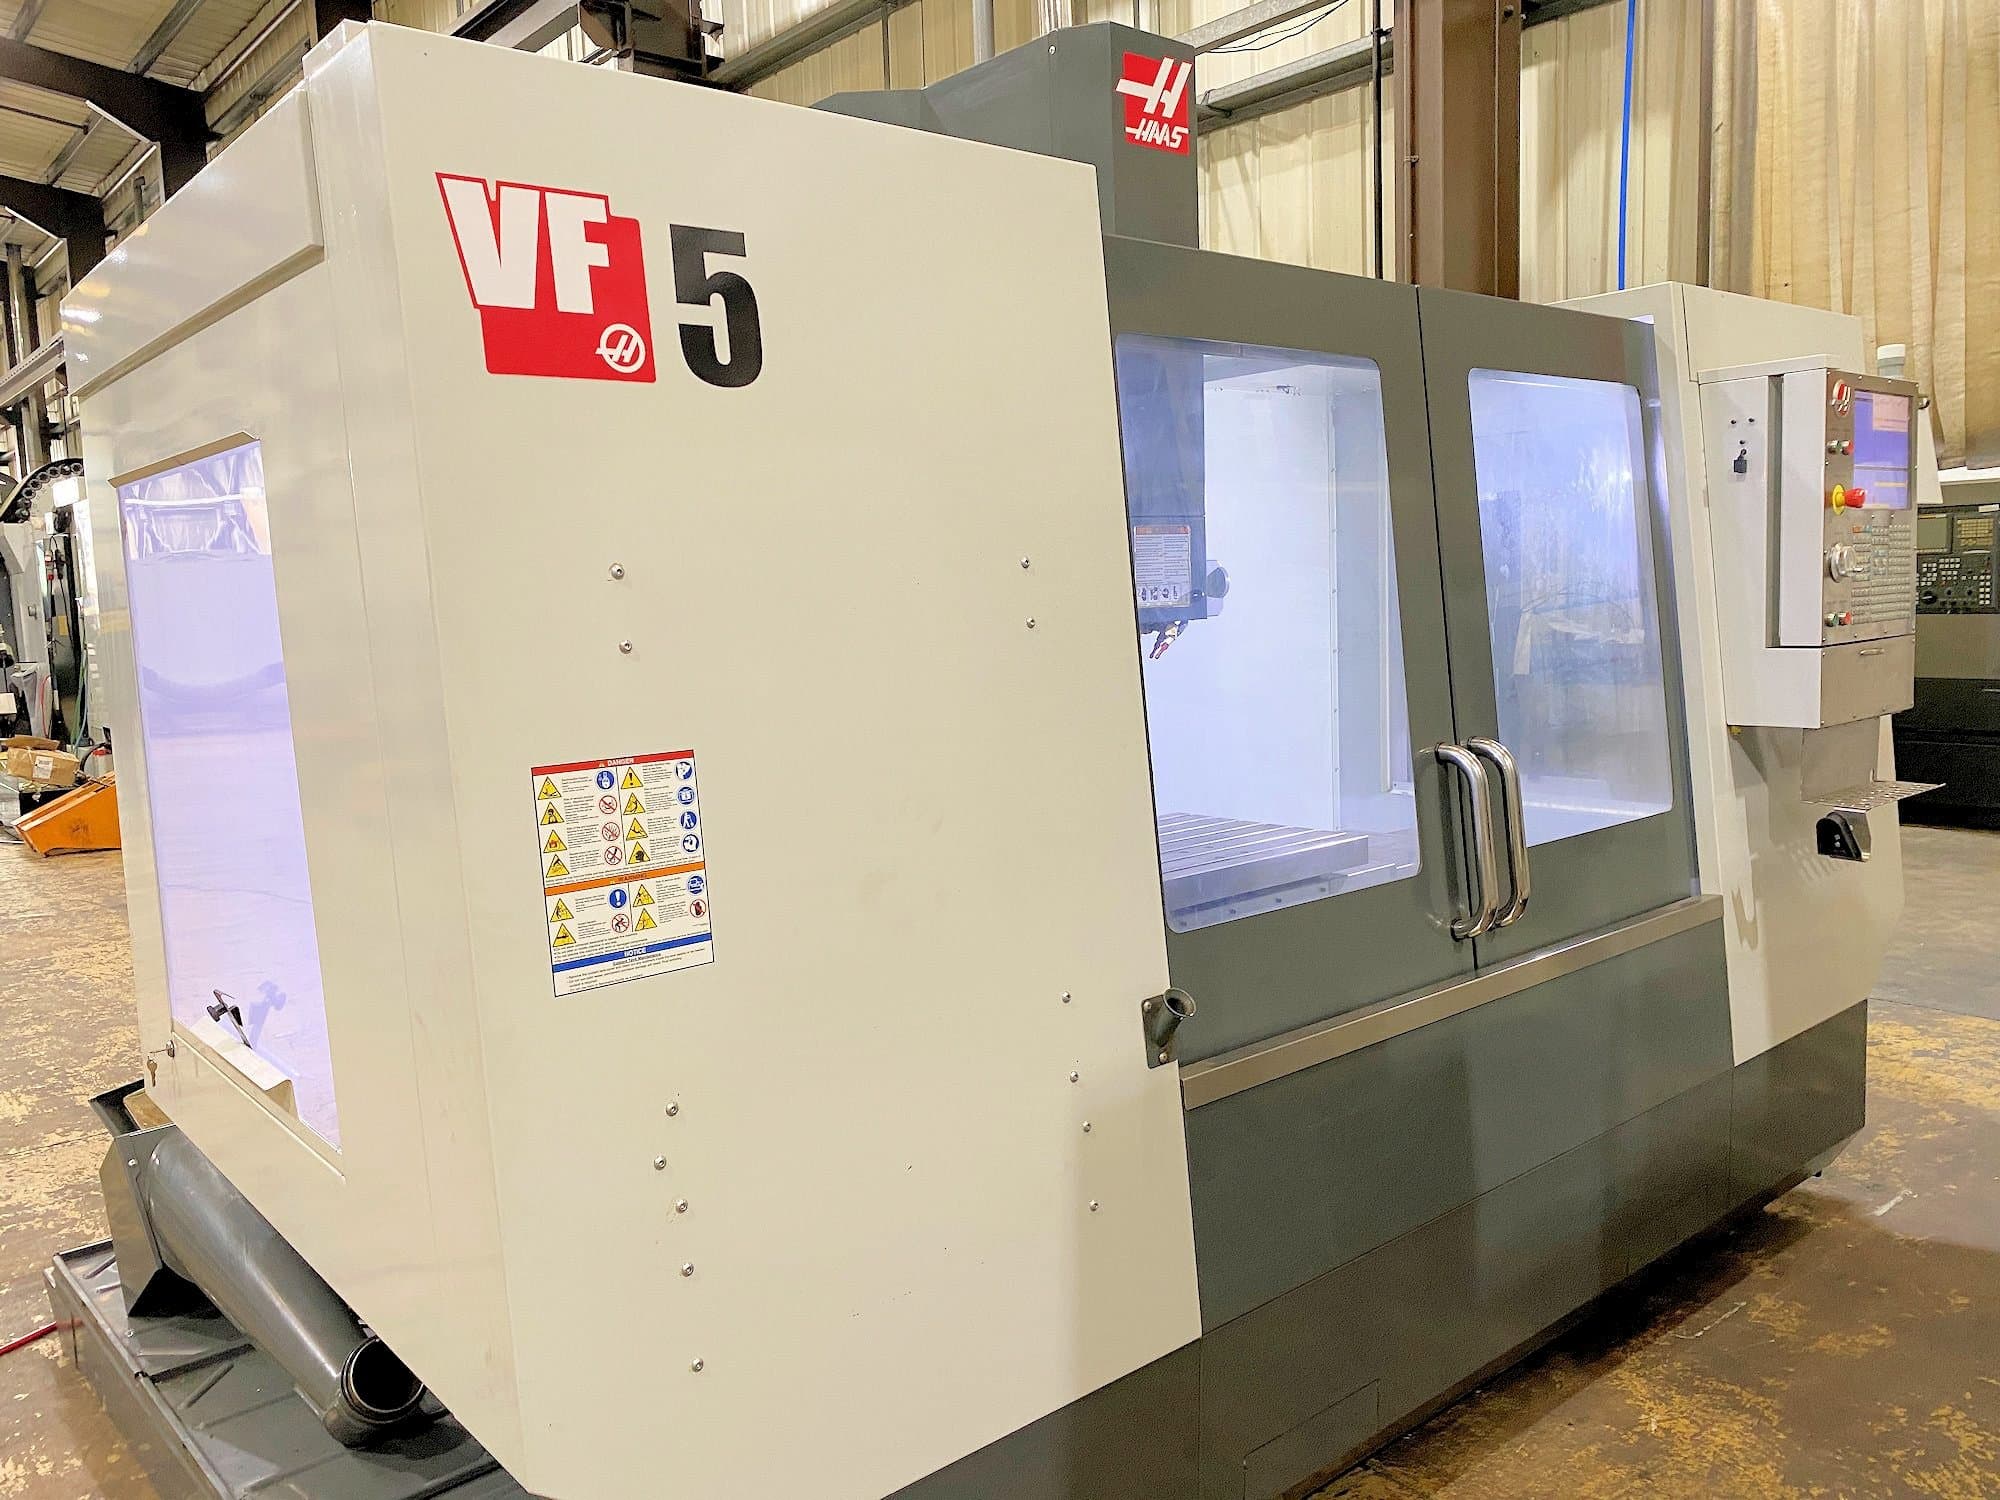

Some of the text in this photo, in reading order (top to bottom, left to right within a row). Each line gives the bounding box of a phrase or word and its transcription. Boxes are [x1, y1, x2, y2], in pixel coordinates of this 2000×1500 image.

[1125, 117, 1189, 149] HAAS
[436, 173, 764, 388] VF 5
[607, 758, 634, 767] DANGER
[623, 947, 647, 957] NOTICE
